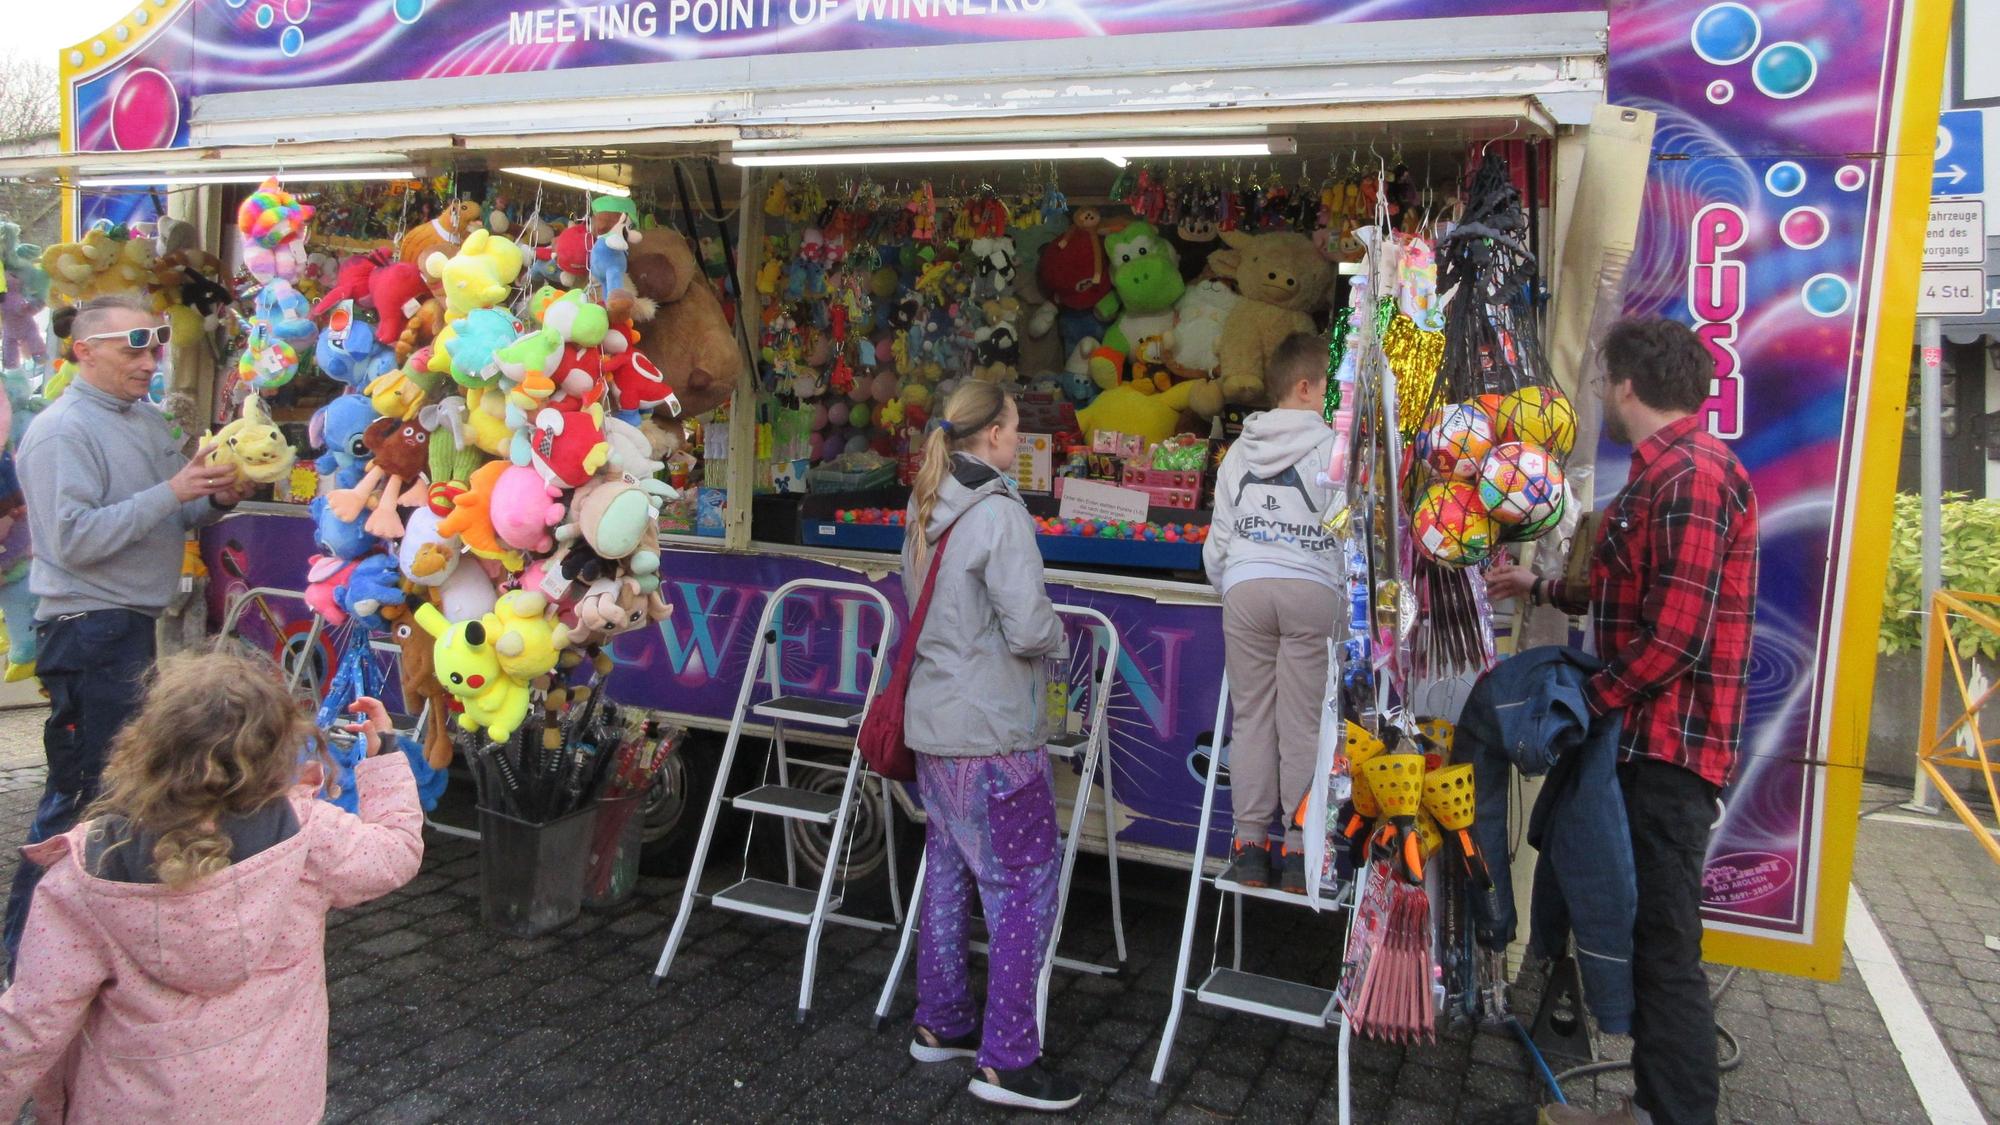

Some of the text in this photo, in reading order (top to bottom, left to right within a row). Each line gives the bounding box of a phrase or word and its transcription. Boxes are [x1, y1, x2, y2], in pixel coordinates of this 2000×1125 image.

[508, 5, 656, 46] MEETING
[669, 0, 770, 35] POINT
[788, 0, 838, 25] OF
[1949, 227, 1967, 238] des
[1926, 285, 1974, 298] 4 Std.
[1688, 202, 1749, 440] PUSH
[1234, 515, 1329, 539] VERYTHIN
[1301, 537, 1337, 551] FOR
[1712, 884, 1729, 893] BAD
